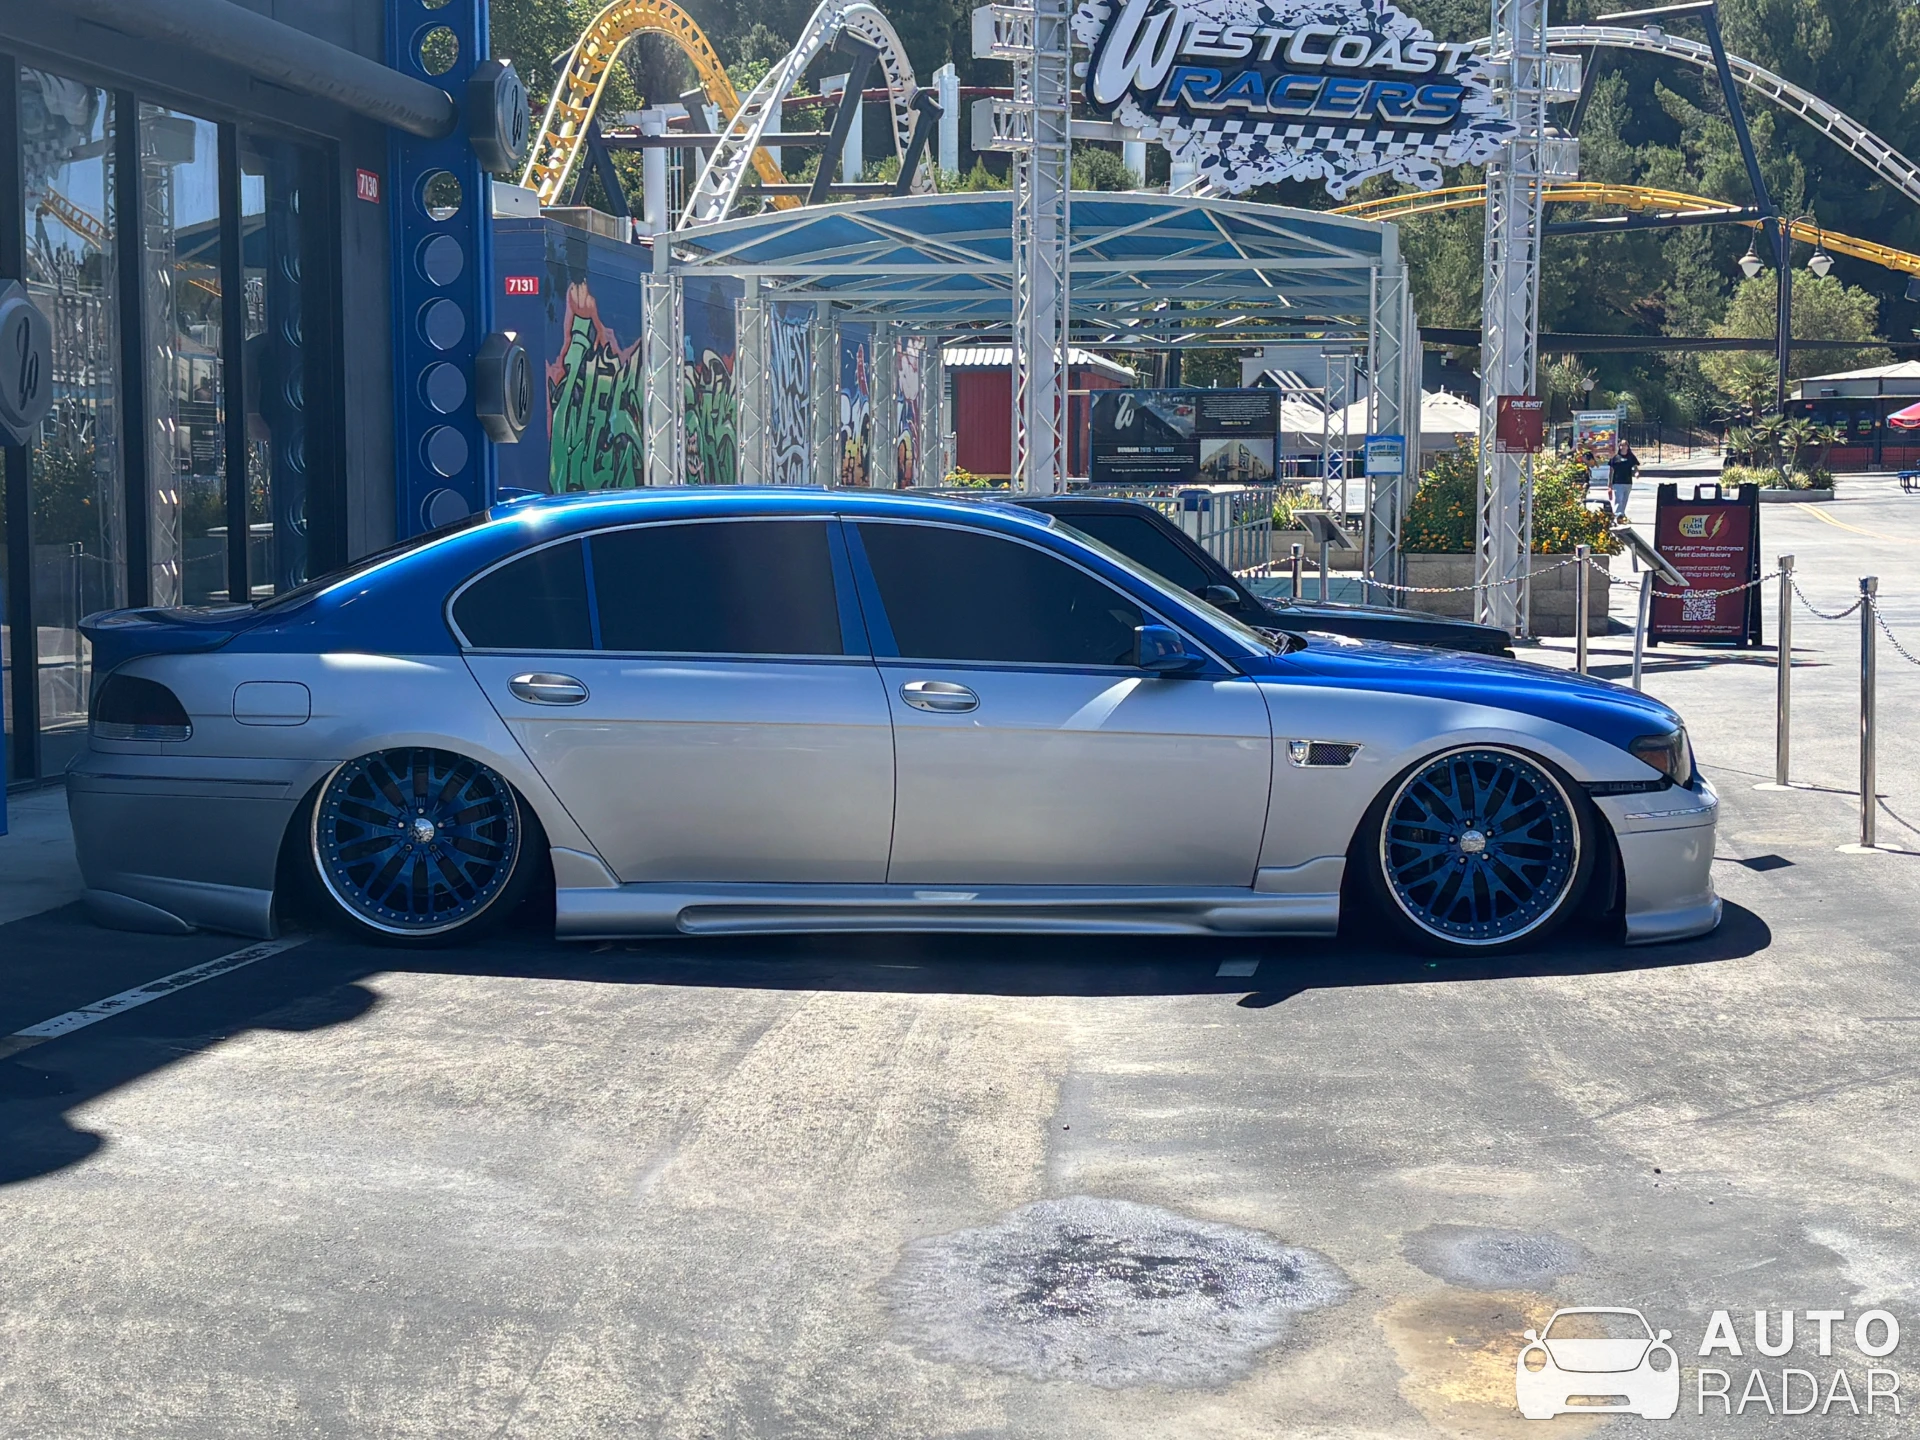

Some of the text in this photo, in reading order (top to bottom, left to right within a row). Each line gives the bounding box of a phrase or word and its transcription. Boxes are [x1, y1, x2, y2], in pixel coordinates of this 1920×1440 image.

[1155, 65, 1466, 125] RACERS
[359, 173, 377, 198] 7130
[509, 279, 534, 292] 7131
[1511, 400, 1544, 408] ONE SHOT
